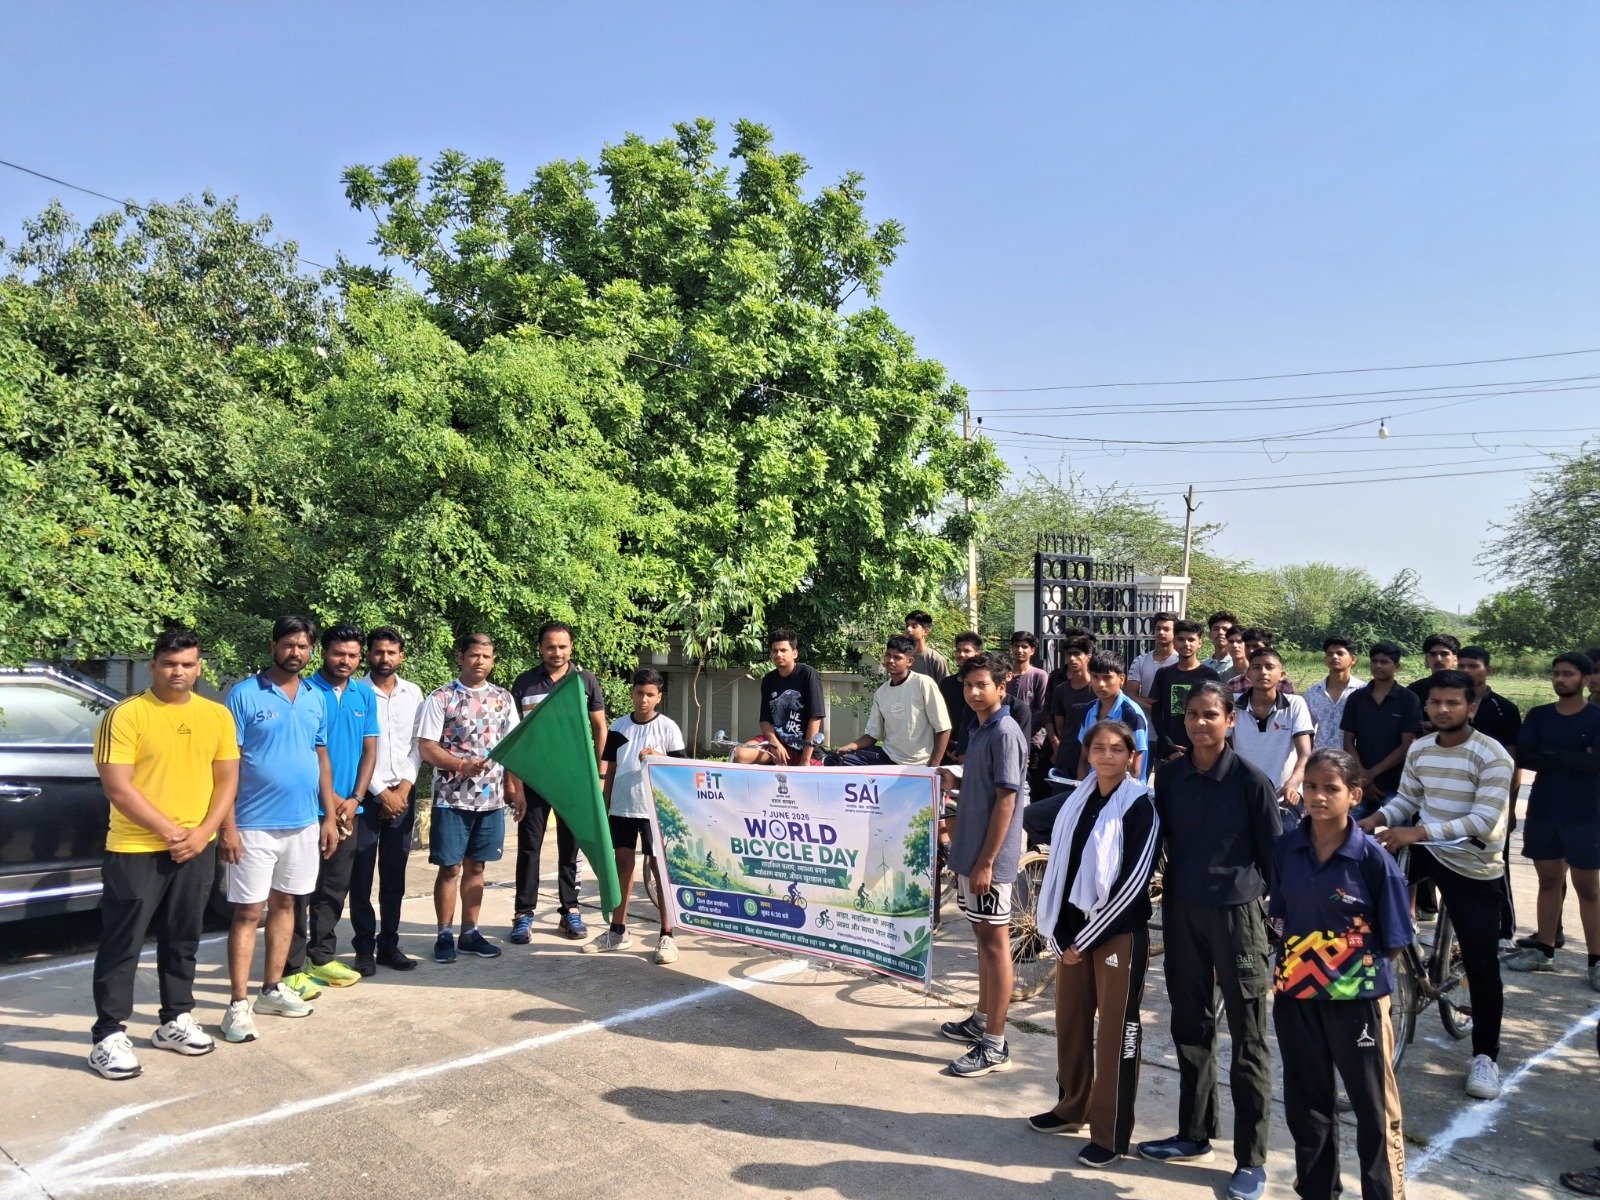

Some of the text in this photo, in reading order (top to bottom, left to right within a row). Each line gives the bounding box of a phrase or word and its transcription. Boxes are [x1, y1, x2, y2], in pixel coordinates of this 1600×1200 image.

[790, 710, 802, 722] WE
[697, 790, 725, 800] INDIA
[844, 783, 879, 804] SAI
[744, 818, 837, 845] WORLD
[730, 837, 859, 868] BICYCLE DAY
[851, 922, 860, 931] और
[872, 916, 878, 925] को
[1123, 1022, 1139, 1059] FASHION
[1391, 1131, 1404, 1194] JORDAN
